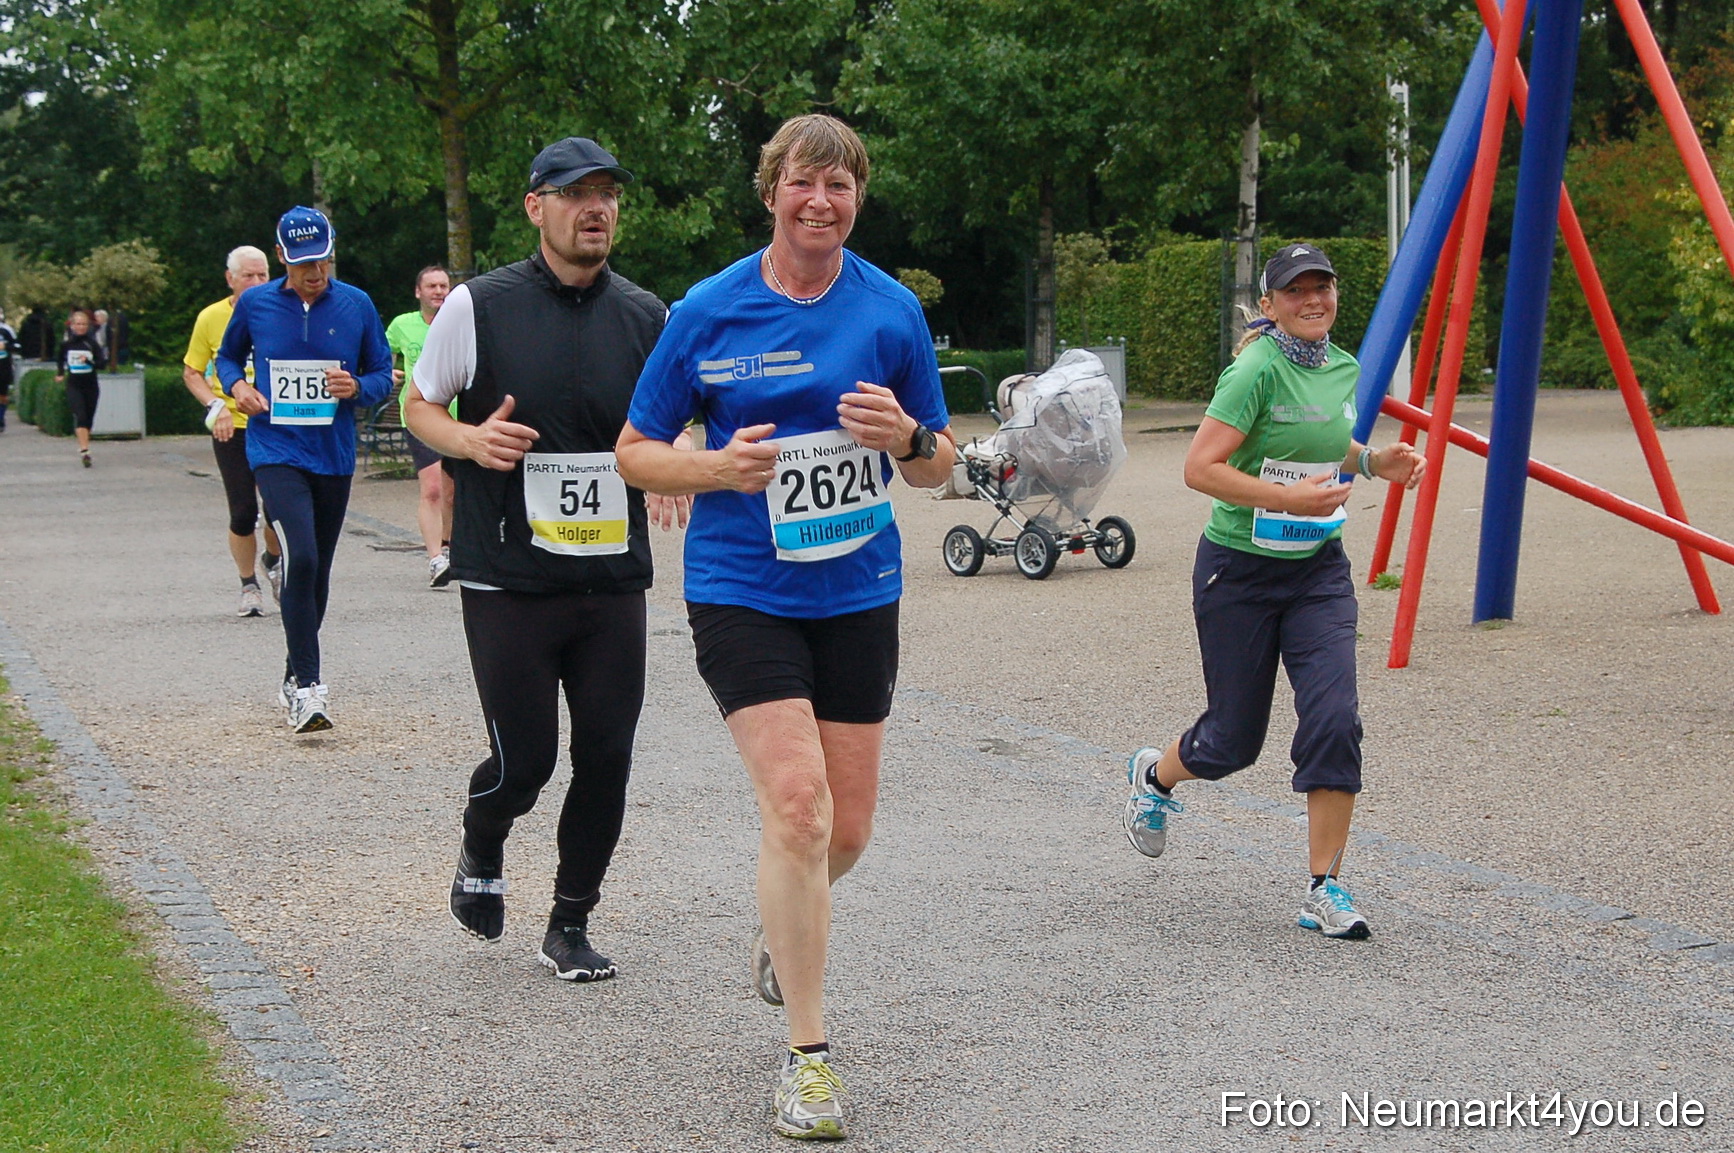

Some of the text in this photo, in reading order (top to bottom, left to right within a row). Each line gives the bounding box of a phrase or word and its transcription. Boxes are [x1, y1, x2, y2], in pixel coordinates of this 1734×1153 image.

[288, 225, 319, 238] ITALIA
[278, 376, 333, 400] 2158
[293, 406, 316, 415] Hans
[774, 440, 864, 463] ARTL Neumark
[526, 463, 564, 473] PARTL
[566, 464, 611, 473] Neumarkt
[1263, 466, 1297, 480] PARTL
[780, 455, 878, 515] 2624
[560, 479, 601, 516] 54
[557, 526, 601, 544] Holger
[800, 512, 875, 544] Hildegard
[1282, 524, 1325, 538] Marion
